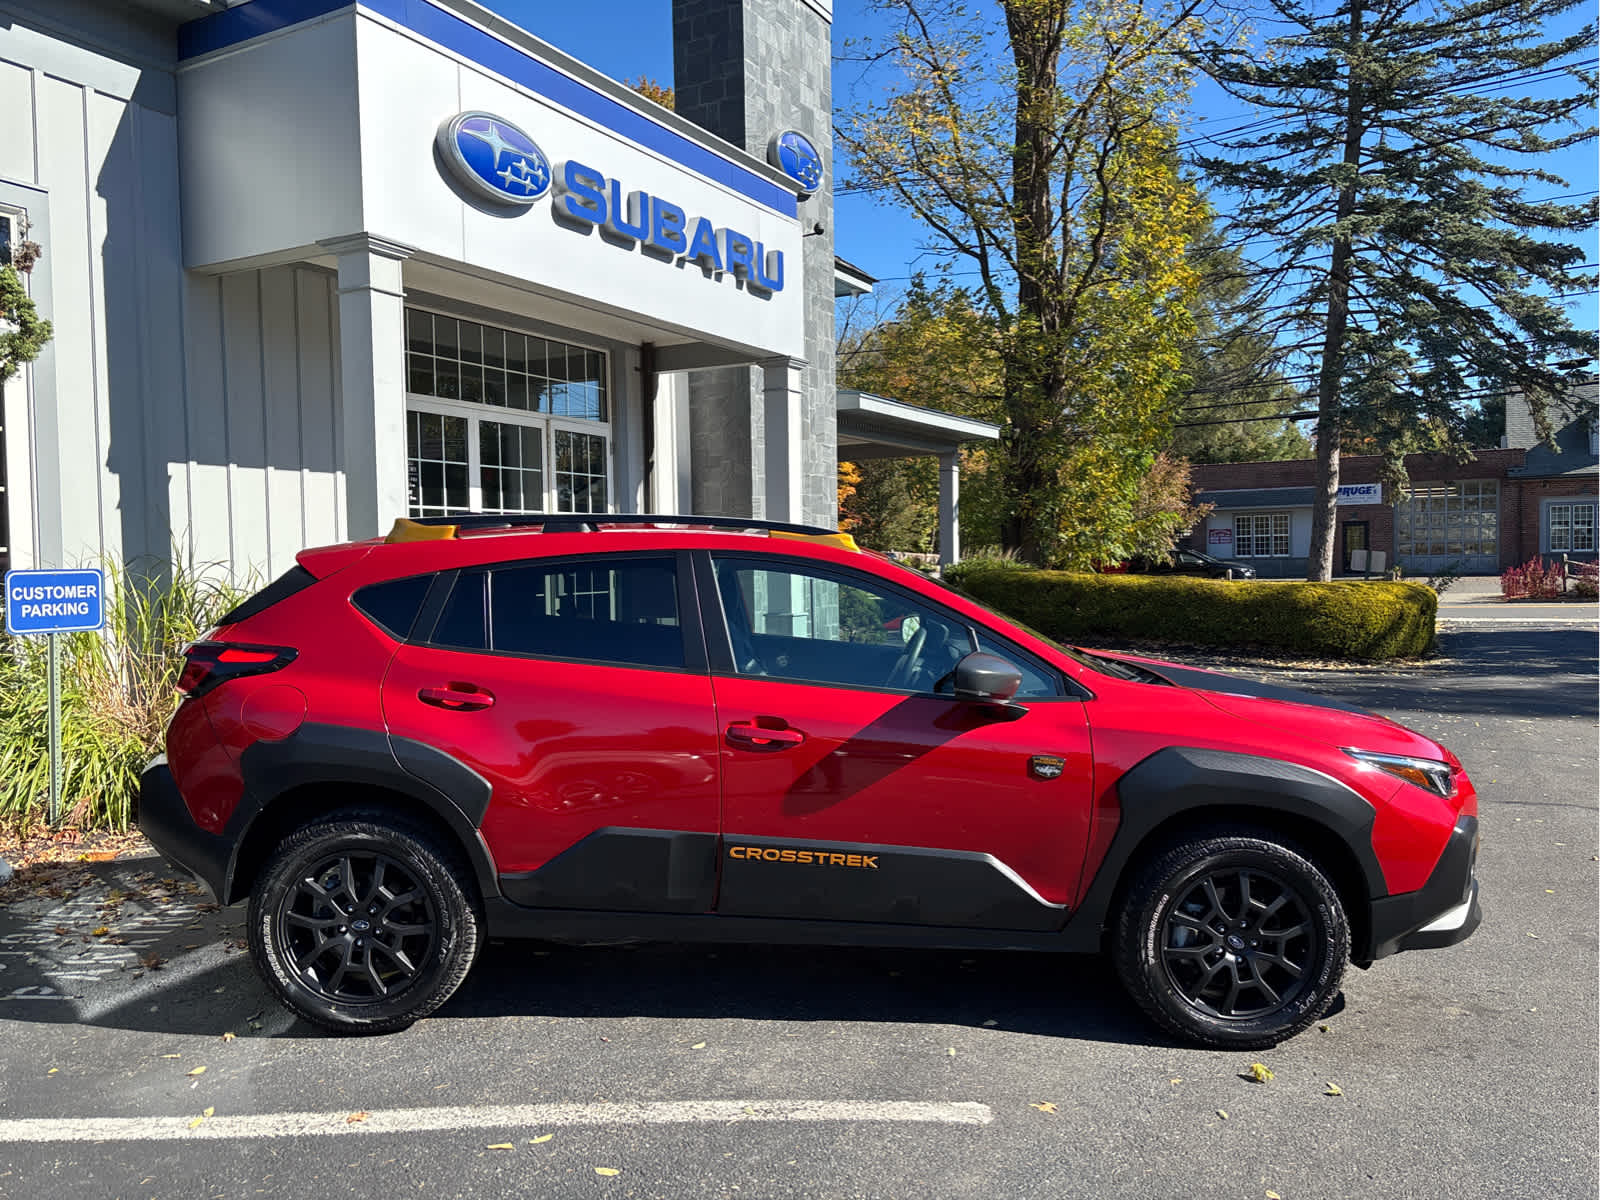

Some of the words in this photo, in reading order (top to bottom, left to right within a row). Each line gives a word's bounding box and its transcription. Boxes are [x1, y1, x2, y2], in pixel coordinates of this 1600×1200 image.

[555, 160, 784, 296] SUBARU
[12, 585, 97, 601] CUSTOMER
[21, 602, 89, 618] PARKING
[729, 846, 879, 869] CROSSTREK
